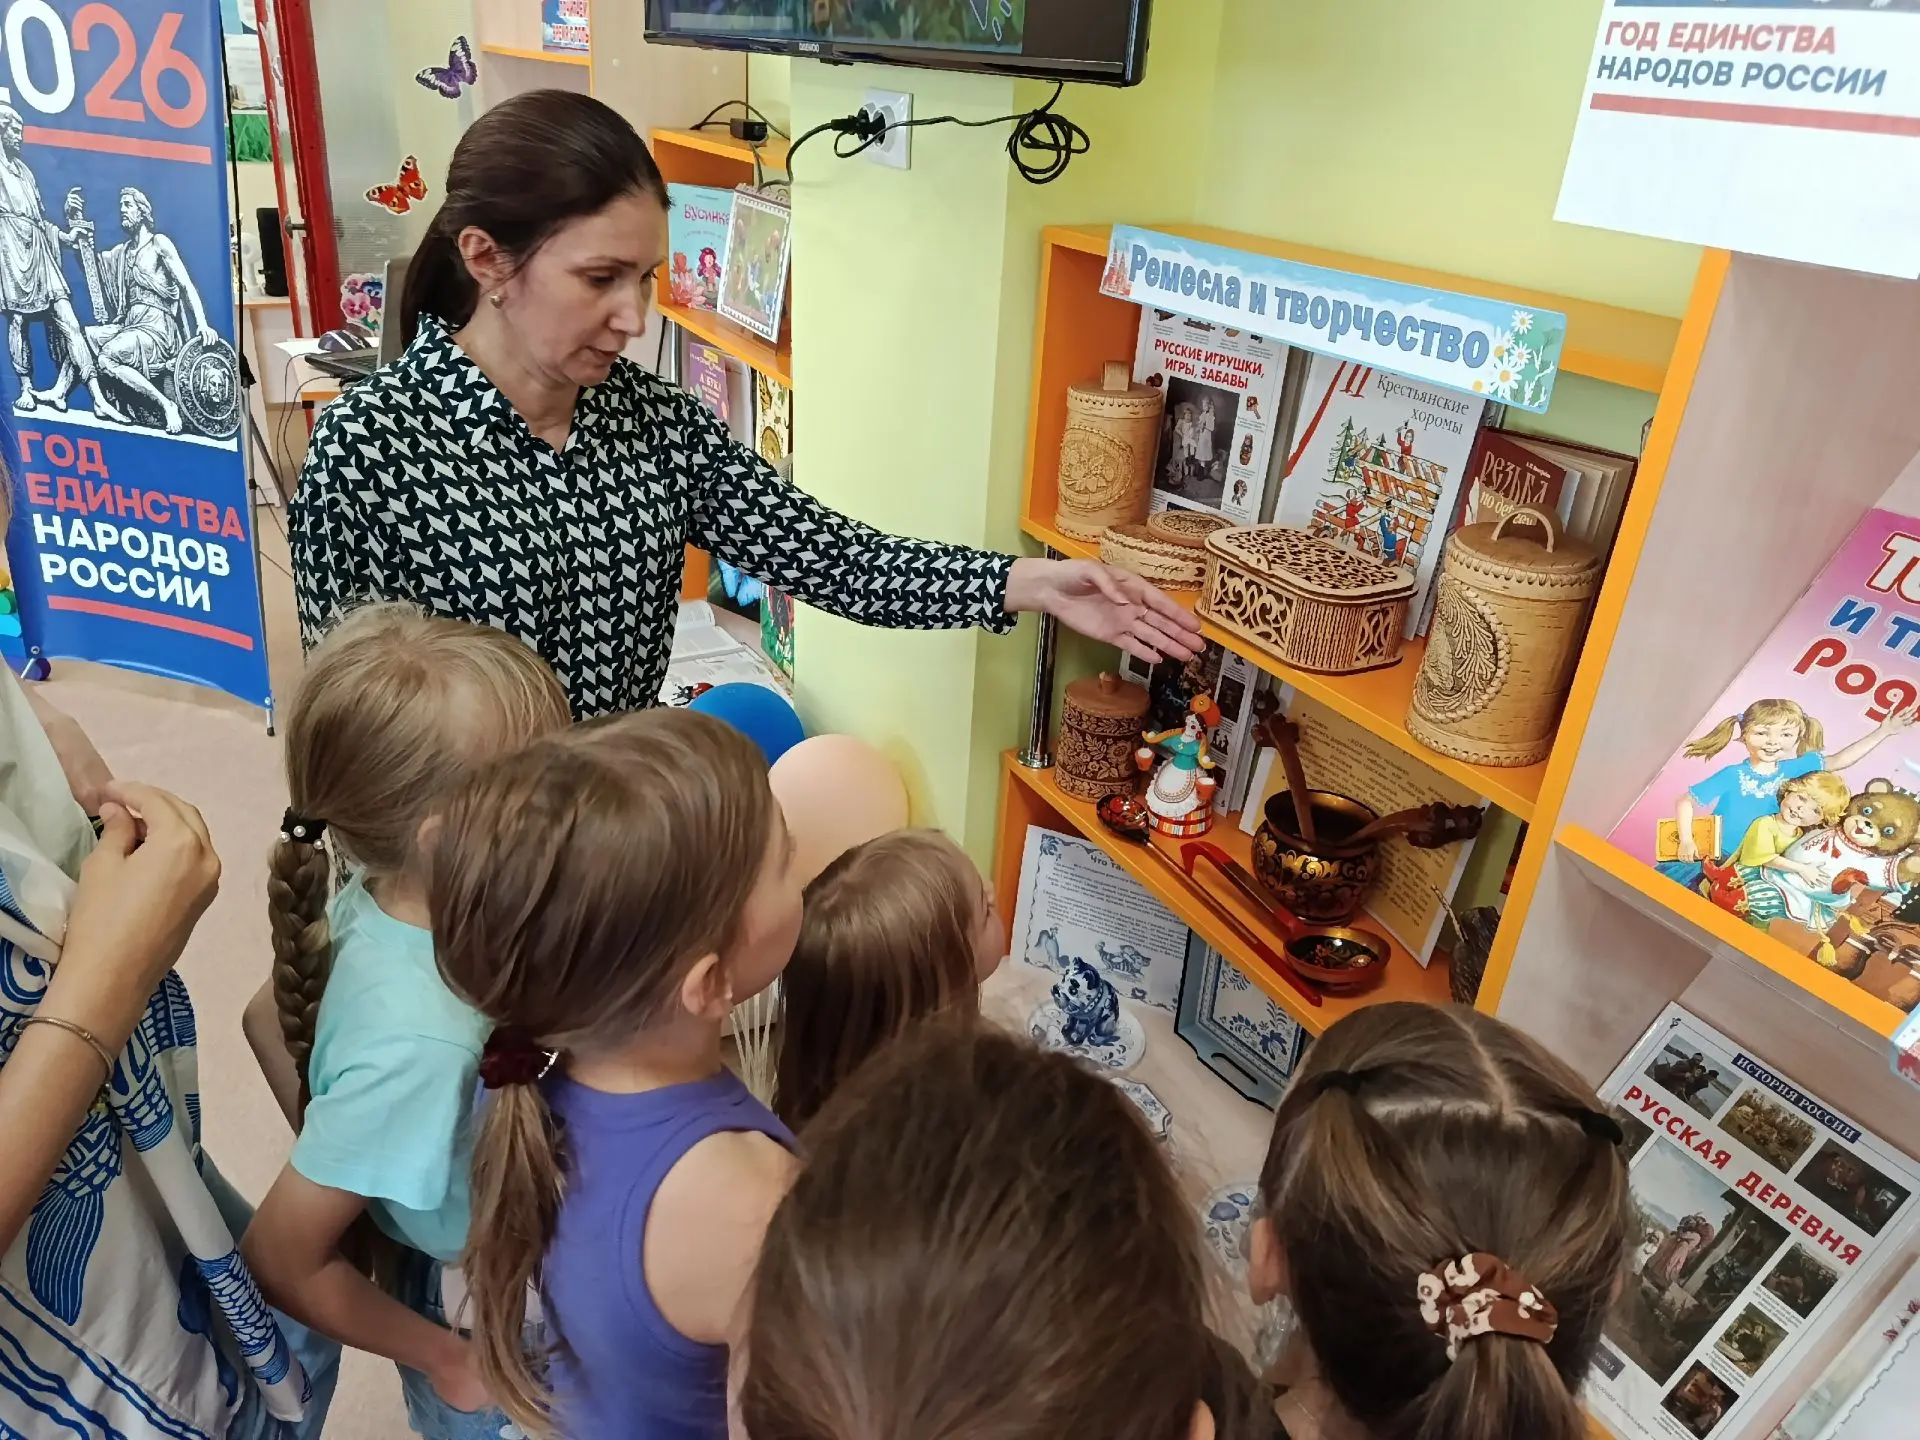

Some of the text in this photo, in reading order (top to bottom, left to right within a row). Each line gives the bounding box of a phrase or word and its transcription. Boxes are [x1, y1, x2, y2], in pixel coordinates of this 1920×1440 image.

[0, 0, 206, 129] 026
[1605, 21, 1836, 54] ГОД ЕДИНСТВА
[1596, 55, 1887, 96] НАРОДОВ РОССИИ
[1129, 244, 1490, 368] Ремесла и творчество
[1154, 338, 1203, 362] РУССКИЕ
[1204, 351, 1265, 378] ИГРУШКИ,
[1164, 357, 1249, 389] ИГРЫ, ЗАБАВЫ
[1377, 374, 1470, 416] Крестьянские
[1411, 408, 1464, 435] хоромы
[20, 430, 109, 479] ГОД
[26, 474, 245, 542] ЕДИНСТВА
[32, 514, 231, 577] НАРОДОВ
[39, 553, 212, 612] РОССИИ
[1793, 638, 1920, 723] Род
[1736, 1056, 1856, 1141] ИСТОРИЯ РОССИИ
[1622, 1084, 1863, 1267] РУССКАЯ ДЕРЕВНЯ
